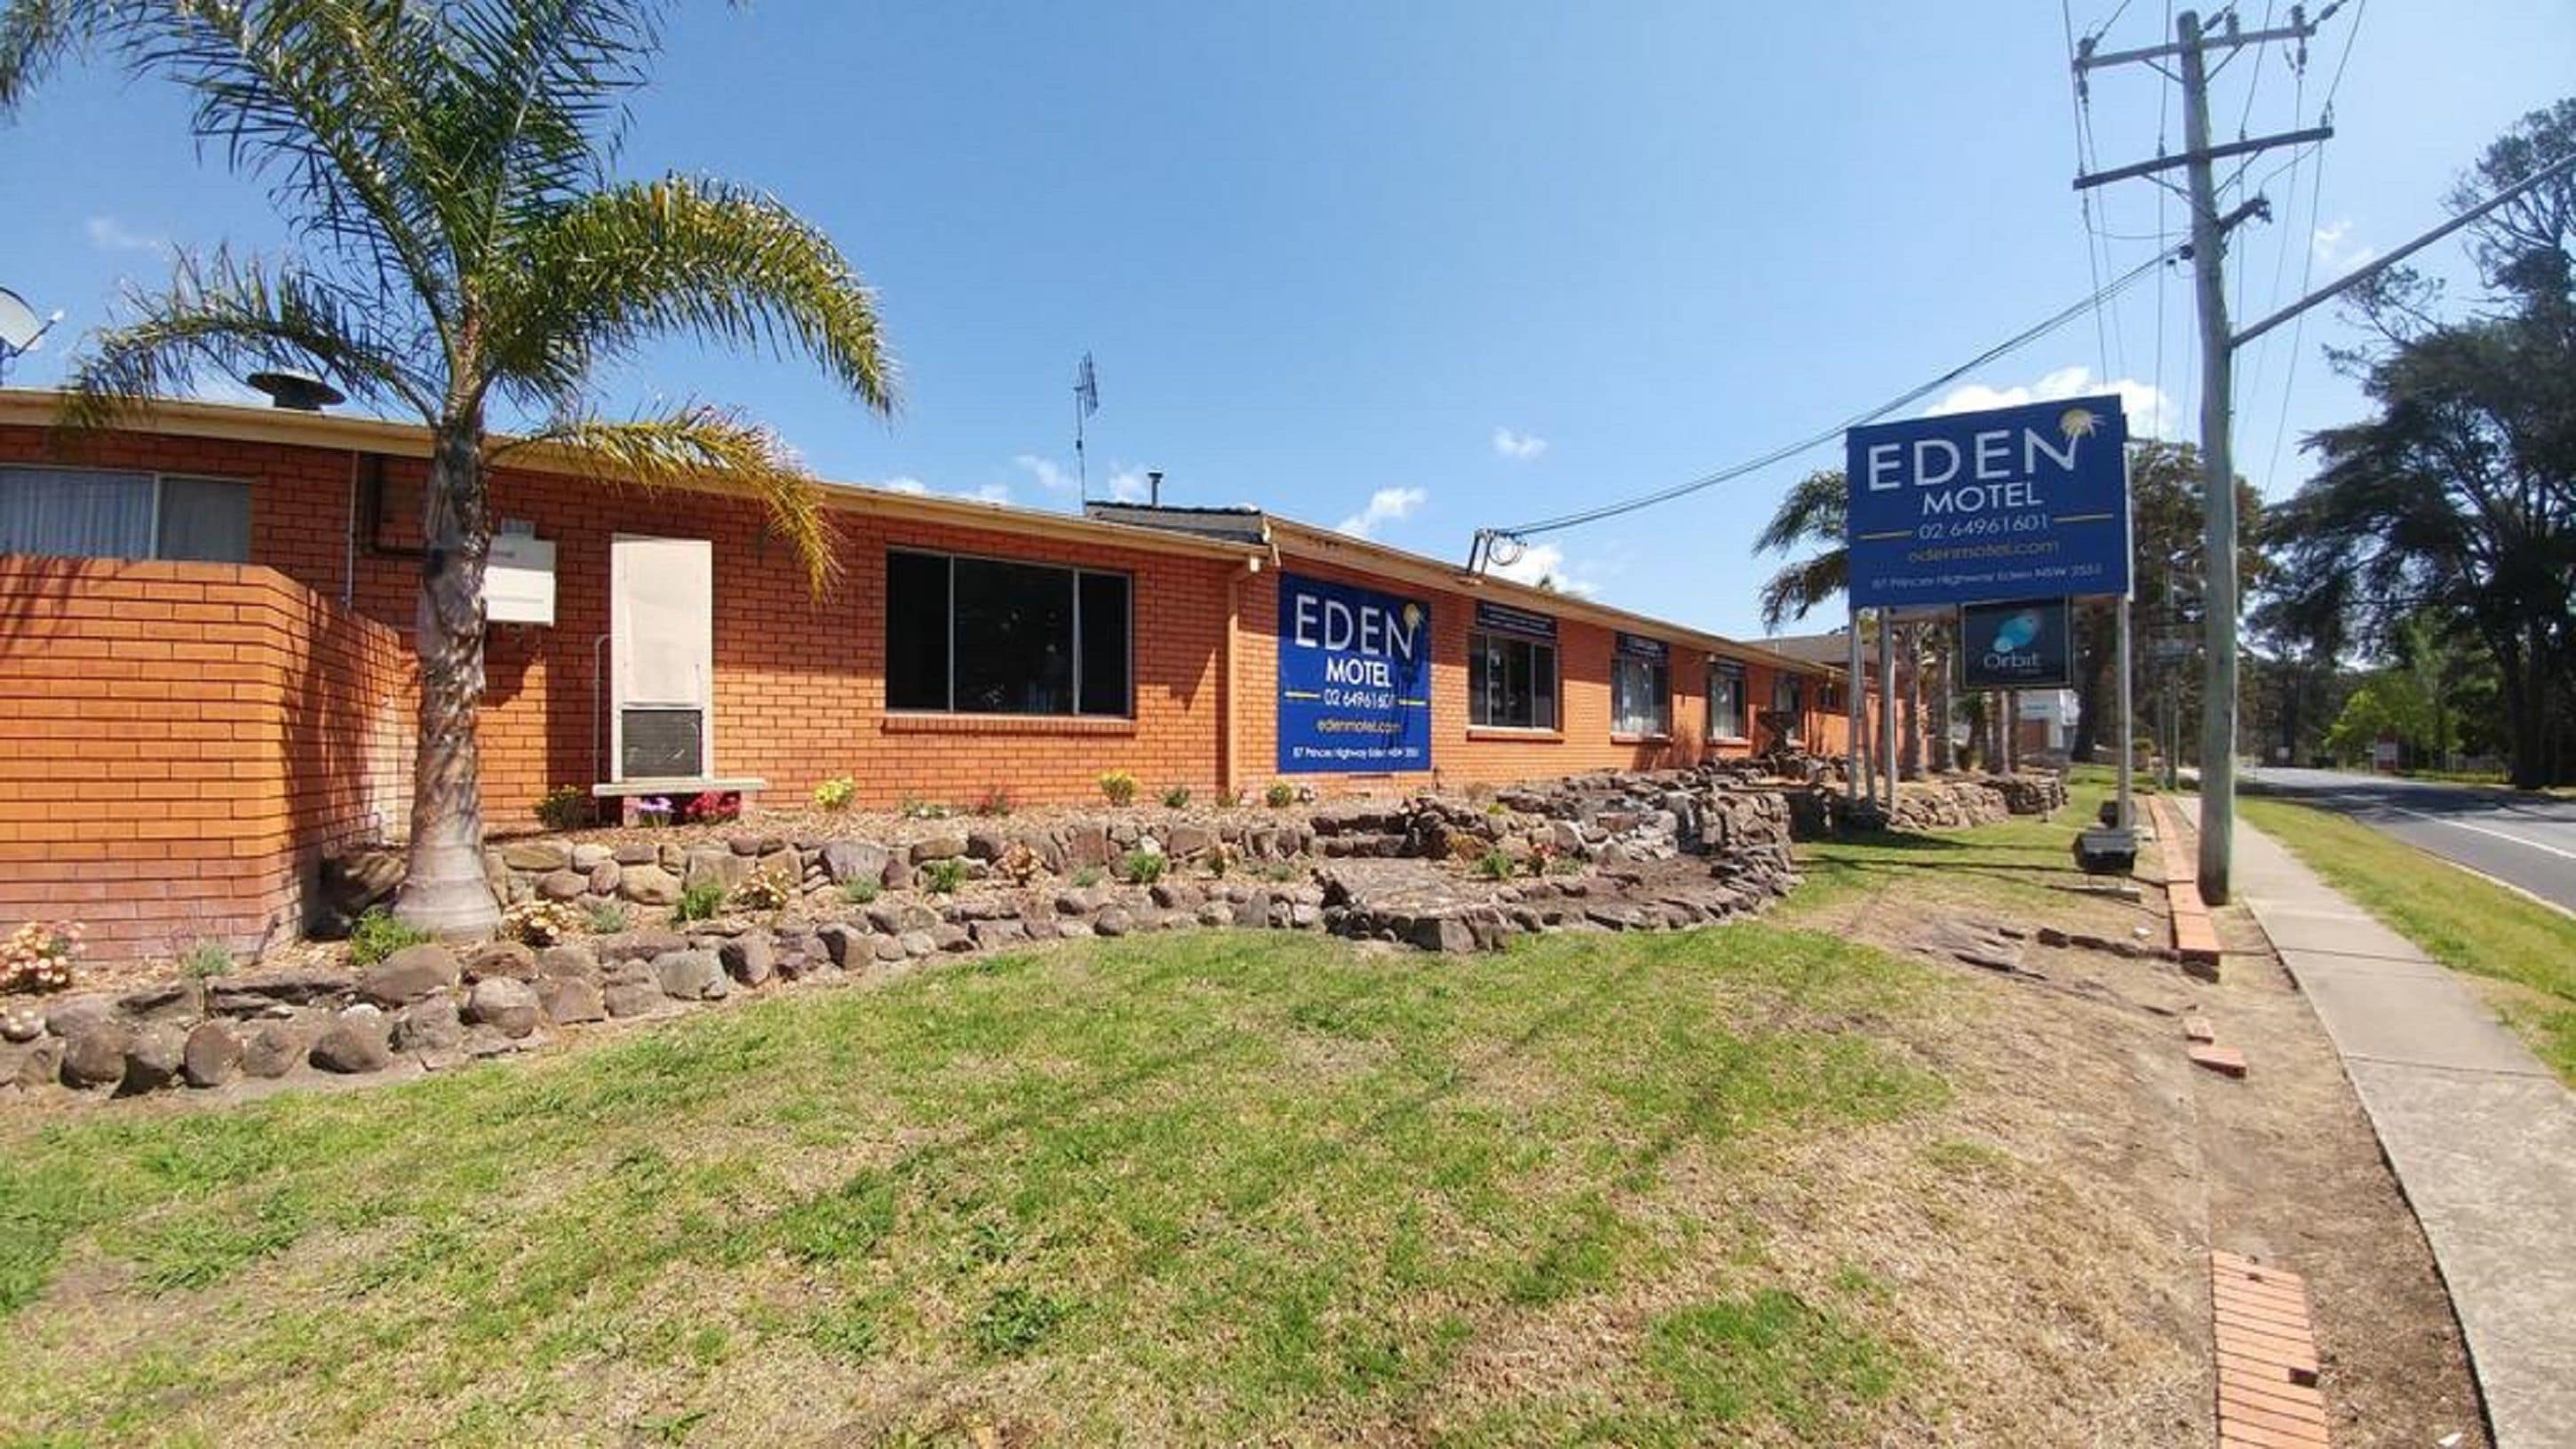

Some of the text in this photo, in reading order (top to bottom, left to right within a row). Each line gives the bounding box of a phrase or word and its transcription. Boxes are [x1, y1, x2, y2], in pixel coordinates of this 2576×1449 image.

[1868, 427, 2080, 491] EDEN
[1923, 482, 2044, 515] MOTEL
[1919, 513, 2048, 539] 02 64961601
[1909, 541, 2060, 563] edenmotel.com
[2035, 566, 2067, 577] NSW
[1295, 593, 1414, 660] EDEN
[1325, 657, 1392, 688] MOTEL
[1984, 653, 2040, 668] Orbit
[1324, 689, 1340, 705] 02
